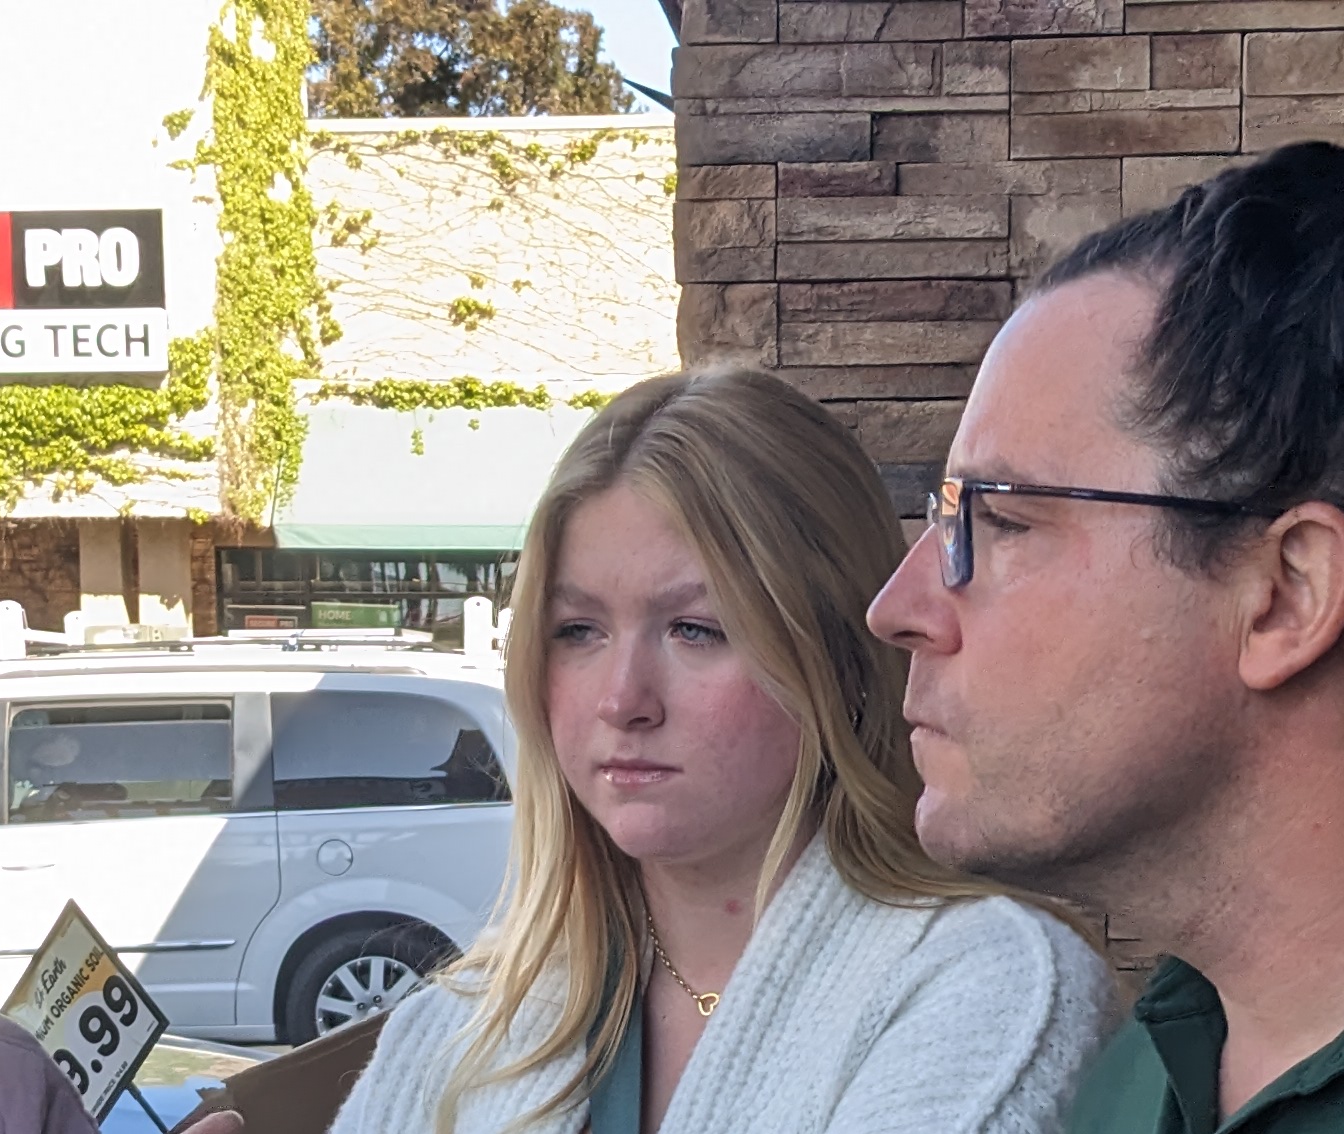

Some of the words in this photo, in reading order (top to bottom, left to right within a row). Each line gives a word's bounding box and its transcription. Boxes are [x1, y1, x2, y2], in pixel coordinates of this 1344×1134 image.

[24, 227, 140, 288] PRO
[44, 323, 151, 358] TECH
[318, 609, 352, 620] HOME
[41, 956, 67, 995] Earth
[50, 967, 89, 1018] ORGANIC
[85, 946, 104, 972] SOIL
